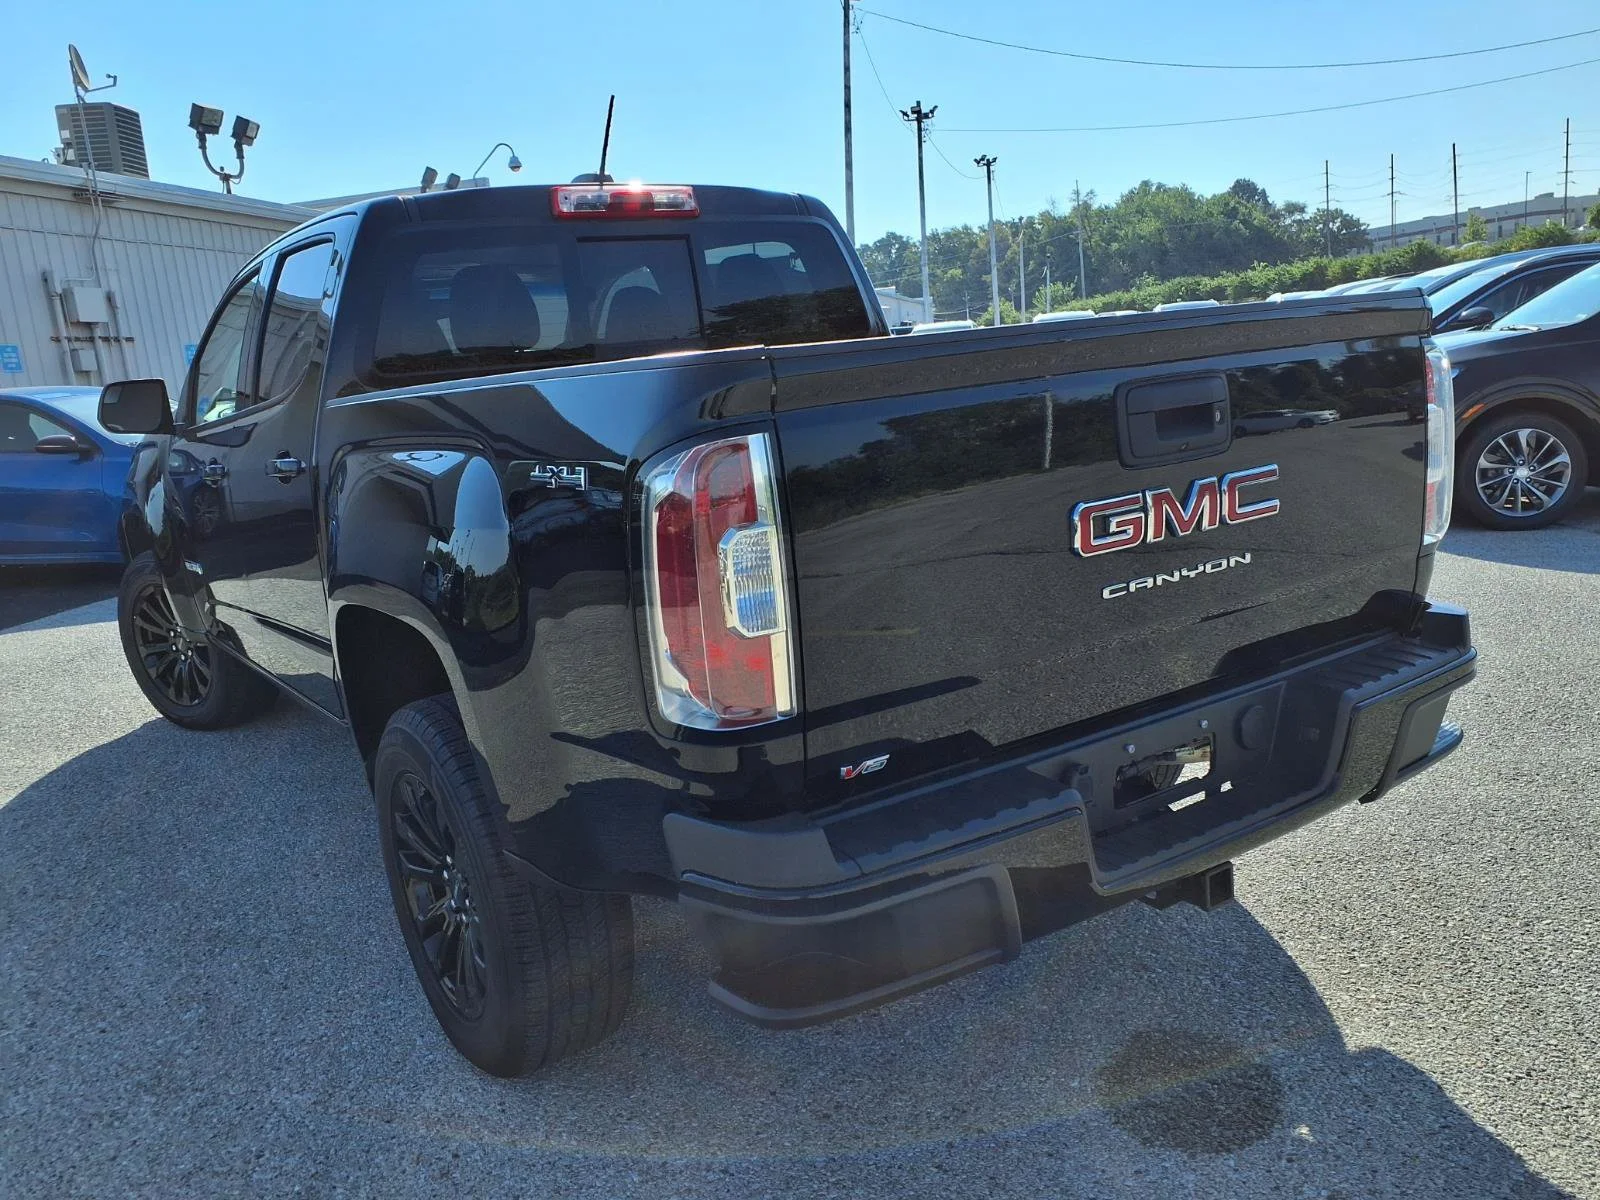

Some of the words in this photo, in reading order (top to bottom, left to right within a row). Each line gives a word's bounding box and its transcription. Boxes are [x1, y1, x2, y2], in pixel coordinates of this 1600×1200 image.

[1071, 463, 1280, 558] GMC
[1102, 552, 1251, 600] CANYON
[840, 754, 890, 779] V6
